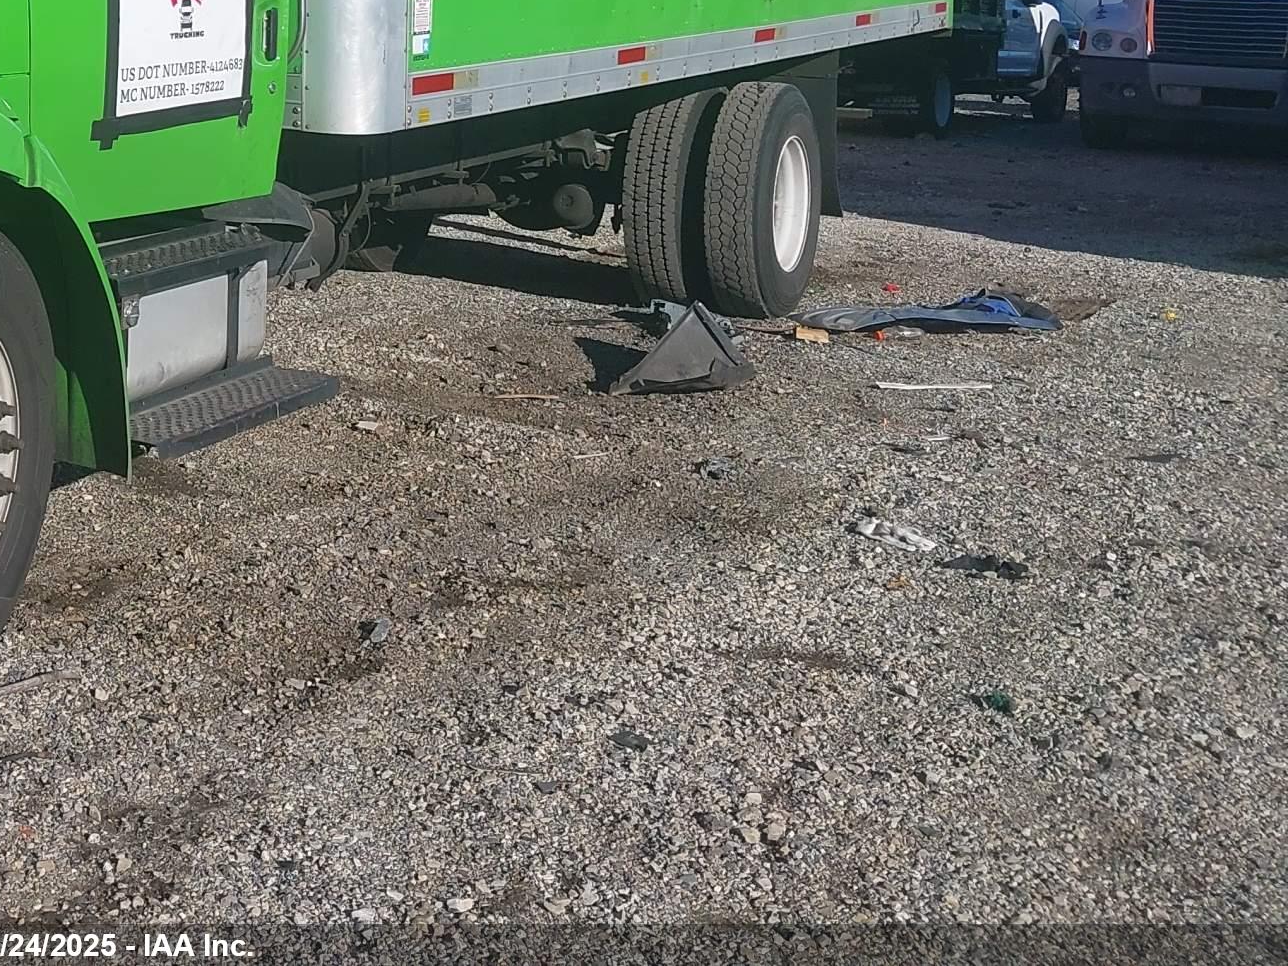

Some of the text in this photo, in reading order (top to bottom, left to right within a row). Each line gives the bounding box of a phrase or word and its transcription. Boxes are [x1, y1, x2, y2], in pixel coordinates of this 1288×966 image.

[120, 67, 136, 82] US
[138, 65, 161, 81] DOT
[120, 88, 138, 103] MC
[191, 80, 225, 95] 1578222
